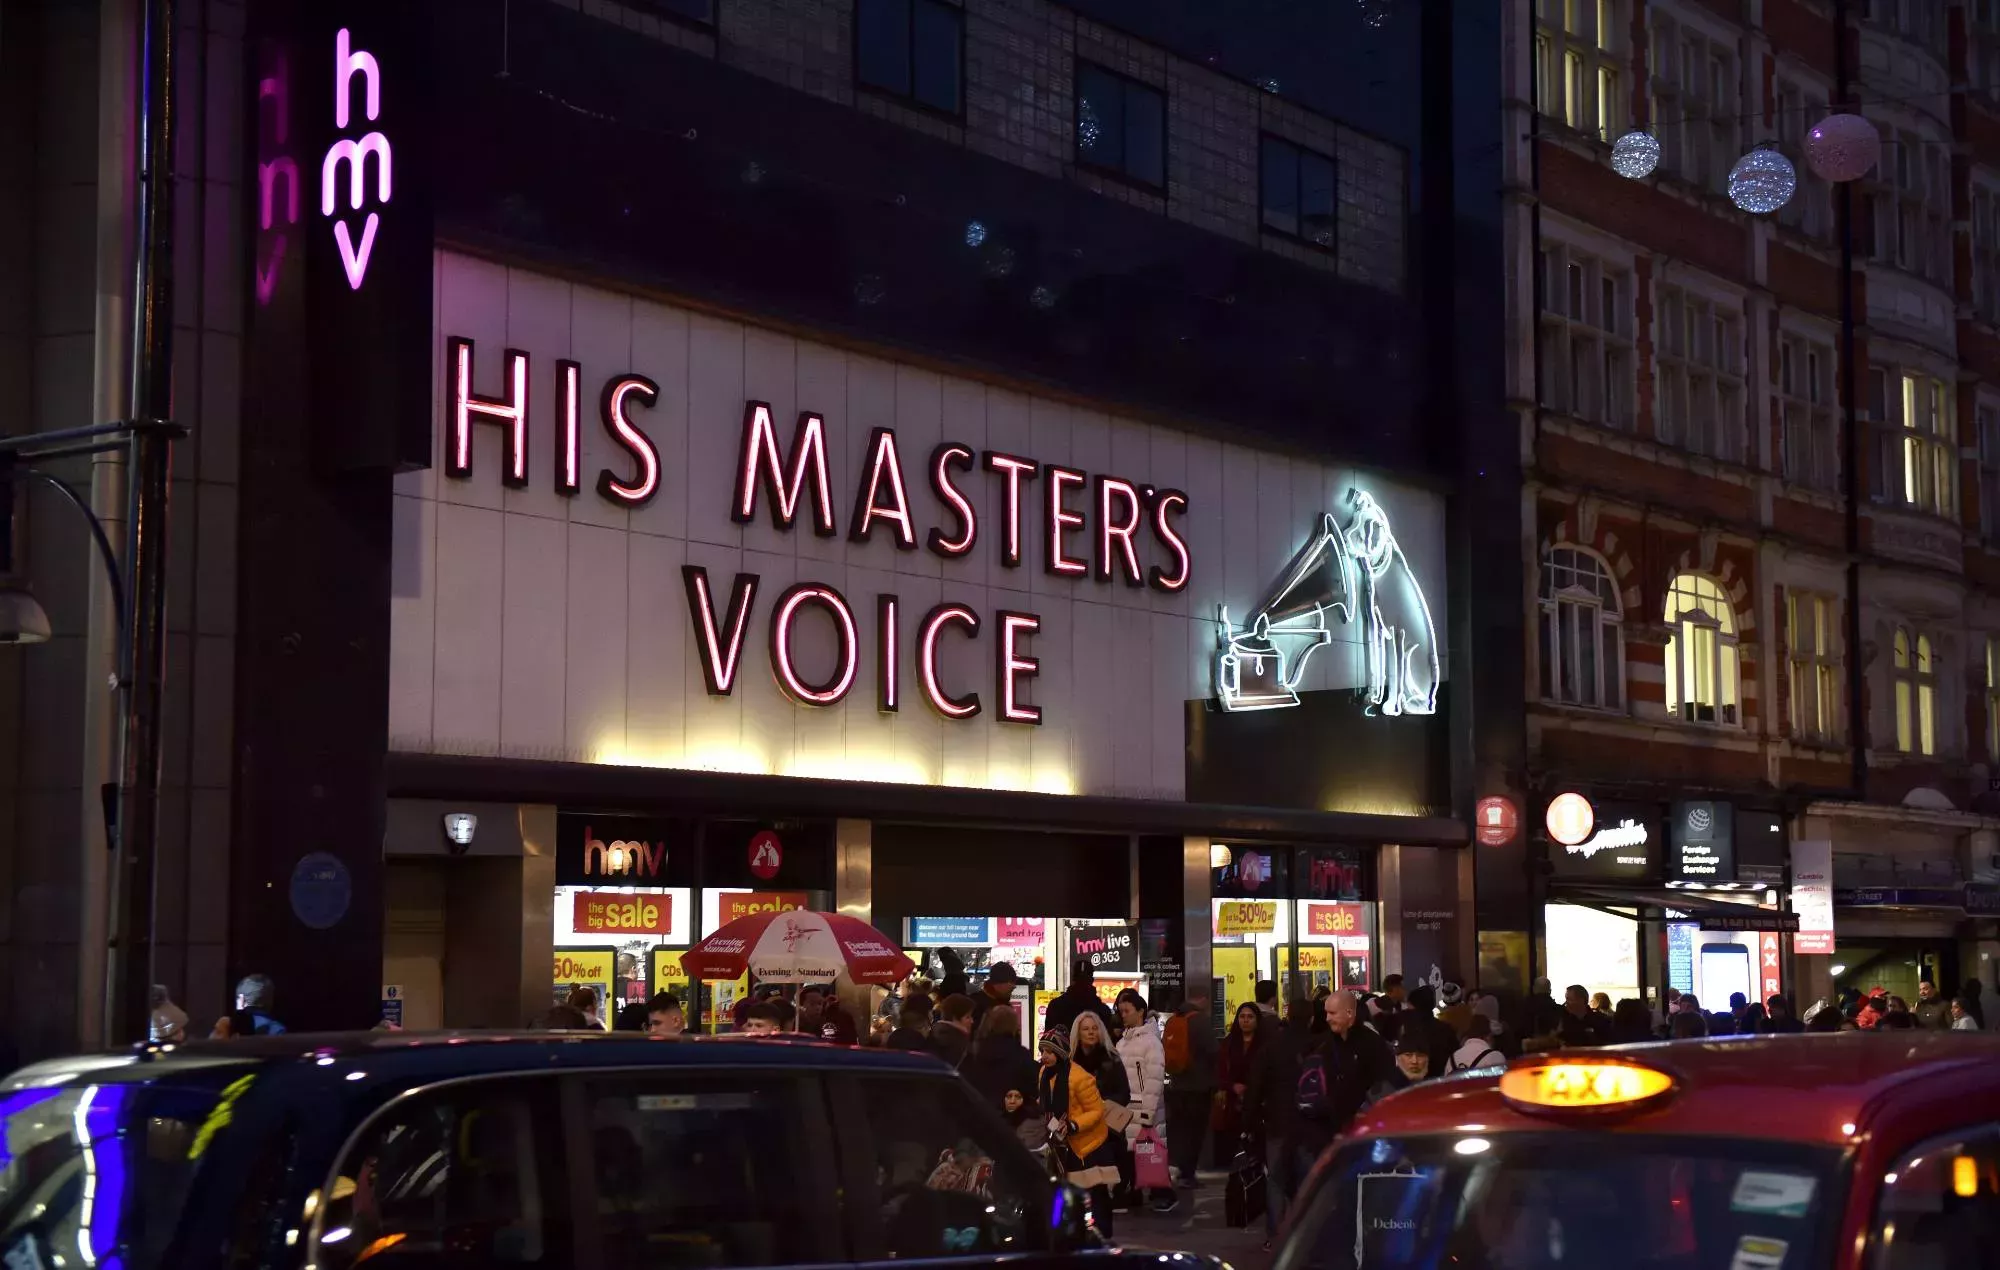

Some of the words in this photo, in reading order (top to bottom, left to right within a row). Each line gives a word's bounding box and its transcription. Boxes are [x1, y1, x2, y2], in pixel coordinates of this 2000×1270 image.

[321, 27, 392, 290] hmv
[445, 336, 661, 507] HIS
[731, 399, 1191, 592] MASTER'S
[681, 564, 1042, 724] VOICE
[584, 825, 664, 876] hmv
[1682, 856, 1720, 865] Exchange
[1682, 865, 1716, 873] Services
[588, 902, 603, 914] the
[606, 896, 659, 928] sale
[732, 901, 746, 913] the
[1239, 903, 1267, 924] 50%
[588, 916, 603, 929] big
[1325, 907, 1355, 931] sale
[1006, 929, 1025, 938] and
[702, 945, 746, 954] Standard
[709, 938, 746, 948] Evening
[1076, 937, 1105, 954] hmv
[1107, 933, 1130, 949] live
[1299, 952, 1318, 967] 50%
[553, 957, 585, 979] 50%
[587, 965, 602, 978] off
[661, 964, 681, 977] CDs
[759, 967, 792, 977] Evening
[797, 967, 836, 977] Standard
[1101, 981, 1124, 999] sal
